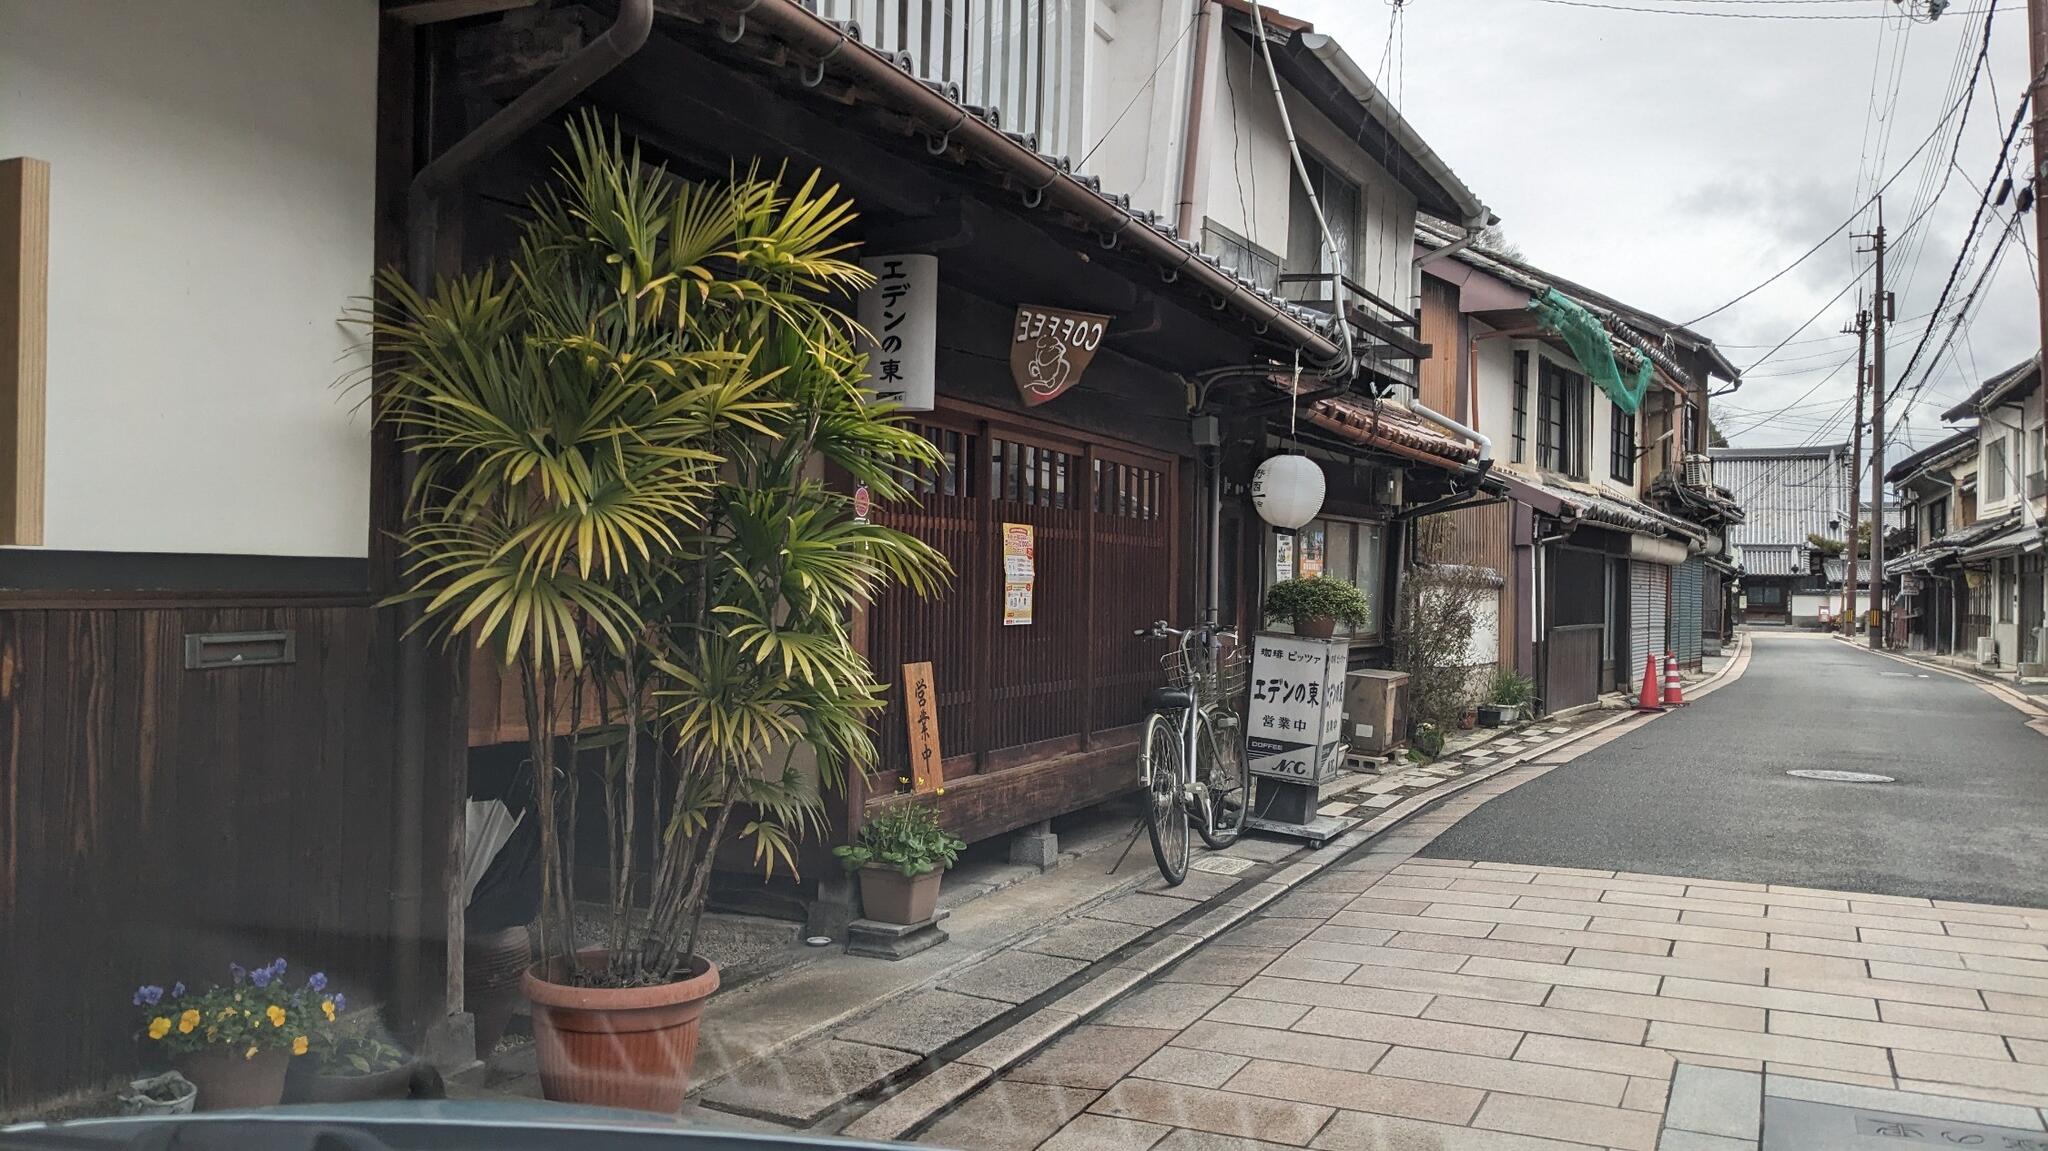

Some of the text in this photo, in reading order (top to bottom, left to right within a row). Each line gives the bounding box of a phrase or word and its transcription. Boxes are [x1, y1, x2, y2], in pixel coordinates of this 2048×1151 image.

[879, 260, 911, 383] エデンの東
[1288, 651, 1320, 664] ピッツァ
[1254, 679, 1320, 708] エデンの東
[915, 678, 932, 774] 営業中
[1263, 715, 1306, 731] 営業中
